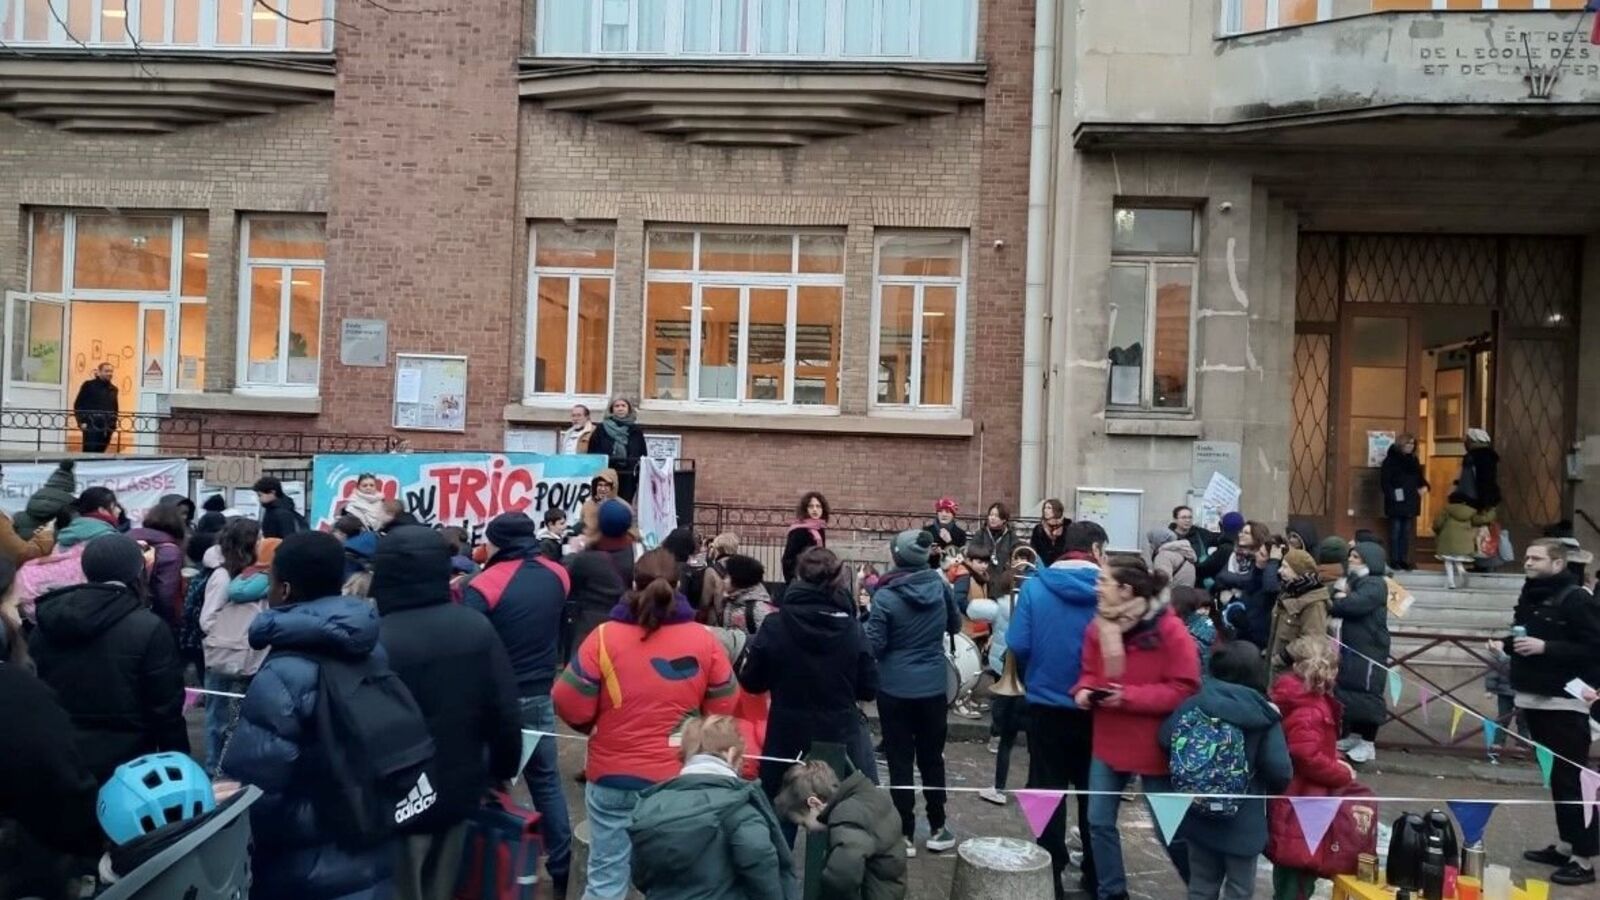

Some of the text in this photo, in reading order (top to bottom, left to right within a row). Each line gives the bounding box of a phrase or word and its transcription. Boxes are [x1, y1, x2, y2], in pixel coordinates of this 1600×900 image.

[1420, 48, 1447, 59] DE
[1550, 48, 1590, 59] DES
[1423, 64, 1449, 75] ET
[1461, 64, 1486, 75] DE
[103, 474, 176, 492] CLASSE
[406, 485, 436, 520] DU
[534, 482, 592, 512] POUR
[394, 792, 438, 824] adidas
